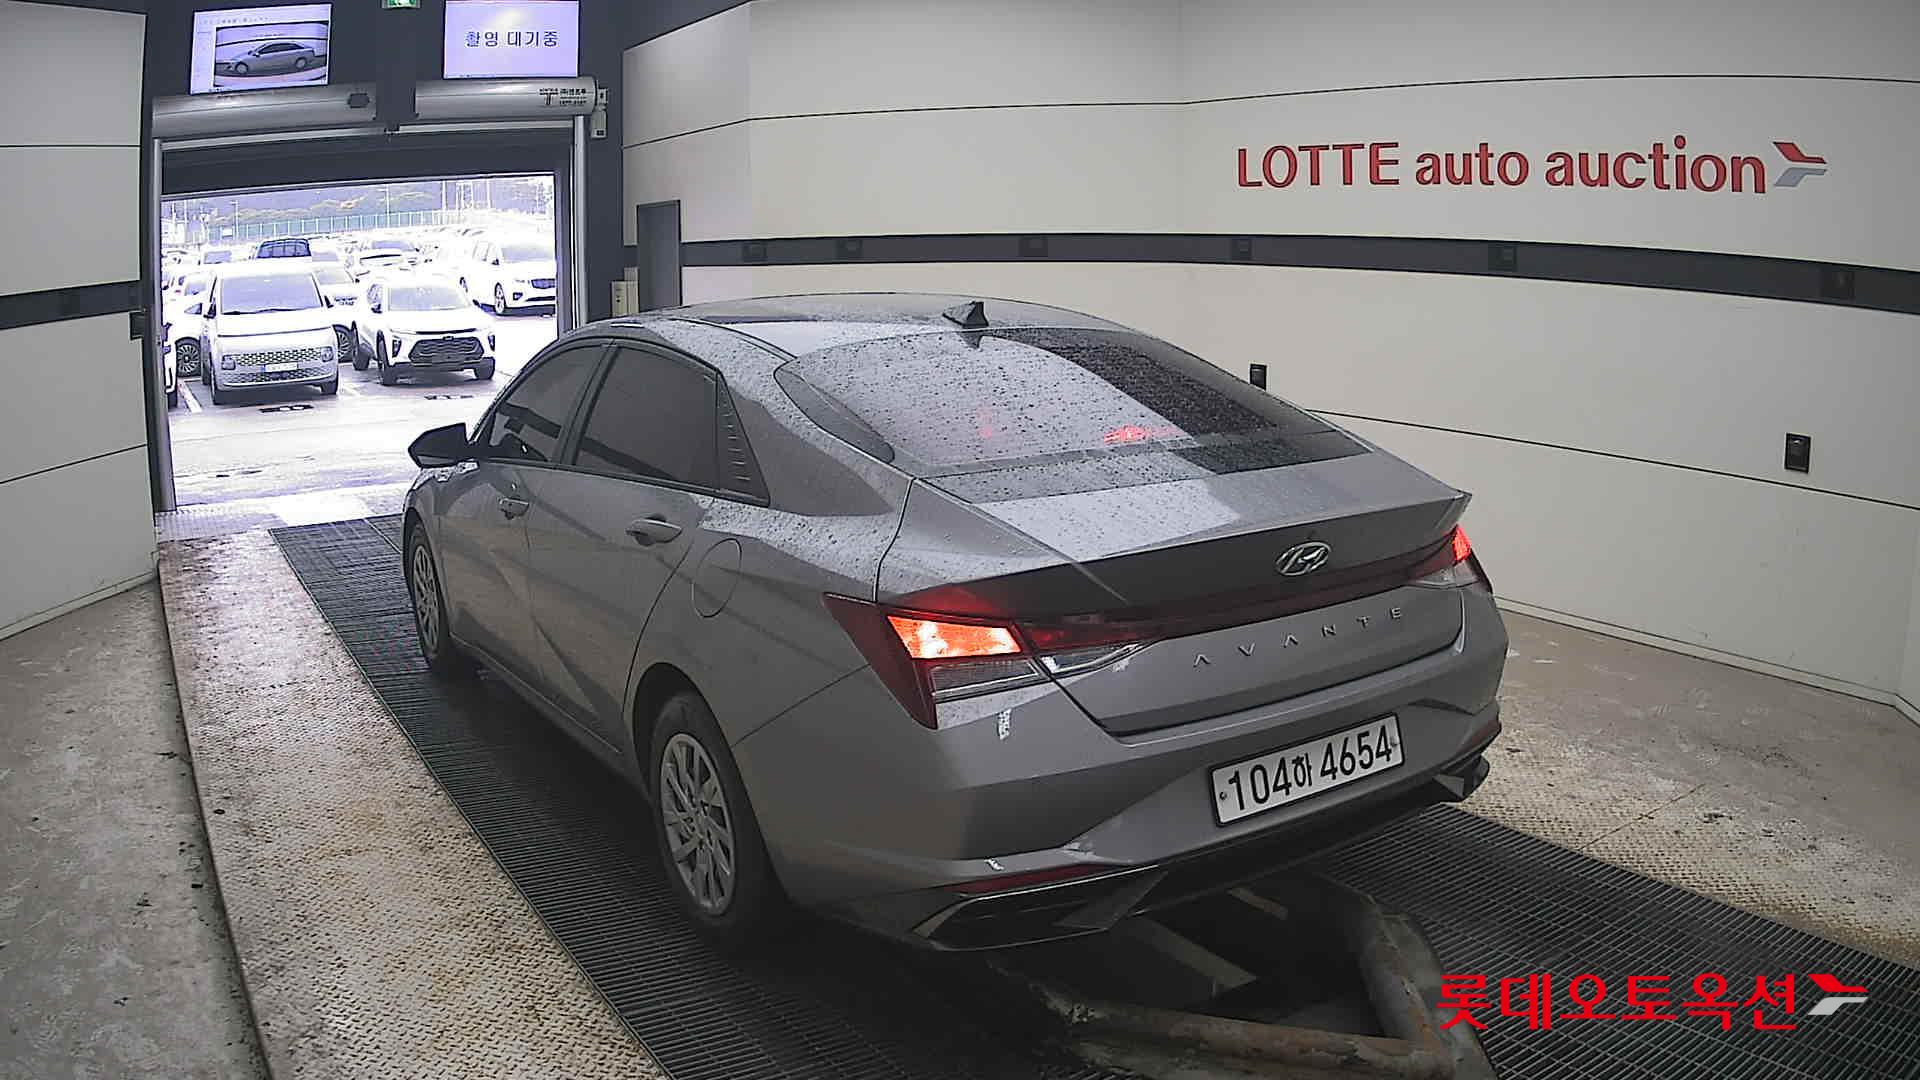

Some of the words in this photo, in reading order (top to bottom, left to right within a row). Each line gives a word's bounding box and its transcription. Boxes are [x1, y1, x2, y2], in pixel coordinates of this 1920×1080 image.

[507, 31, 558, 48] 대기중
[1238, 142, 1400, 188] LOTTE
[1415, 143, 1529, 187] auto
[1544, 135, 1766, 194] auction
[1193, 606, 1402, 668] AVANTE
[1228, 752, 1312, 811] 104하
[1320, 725, 1392, 779] 4654
